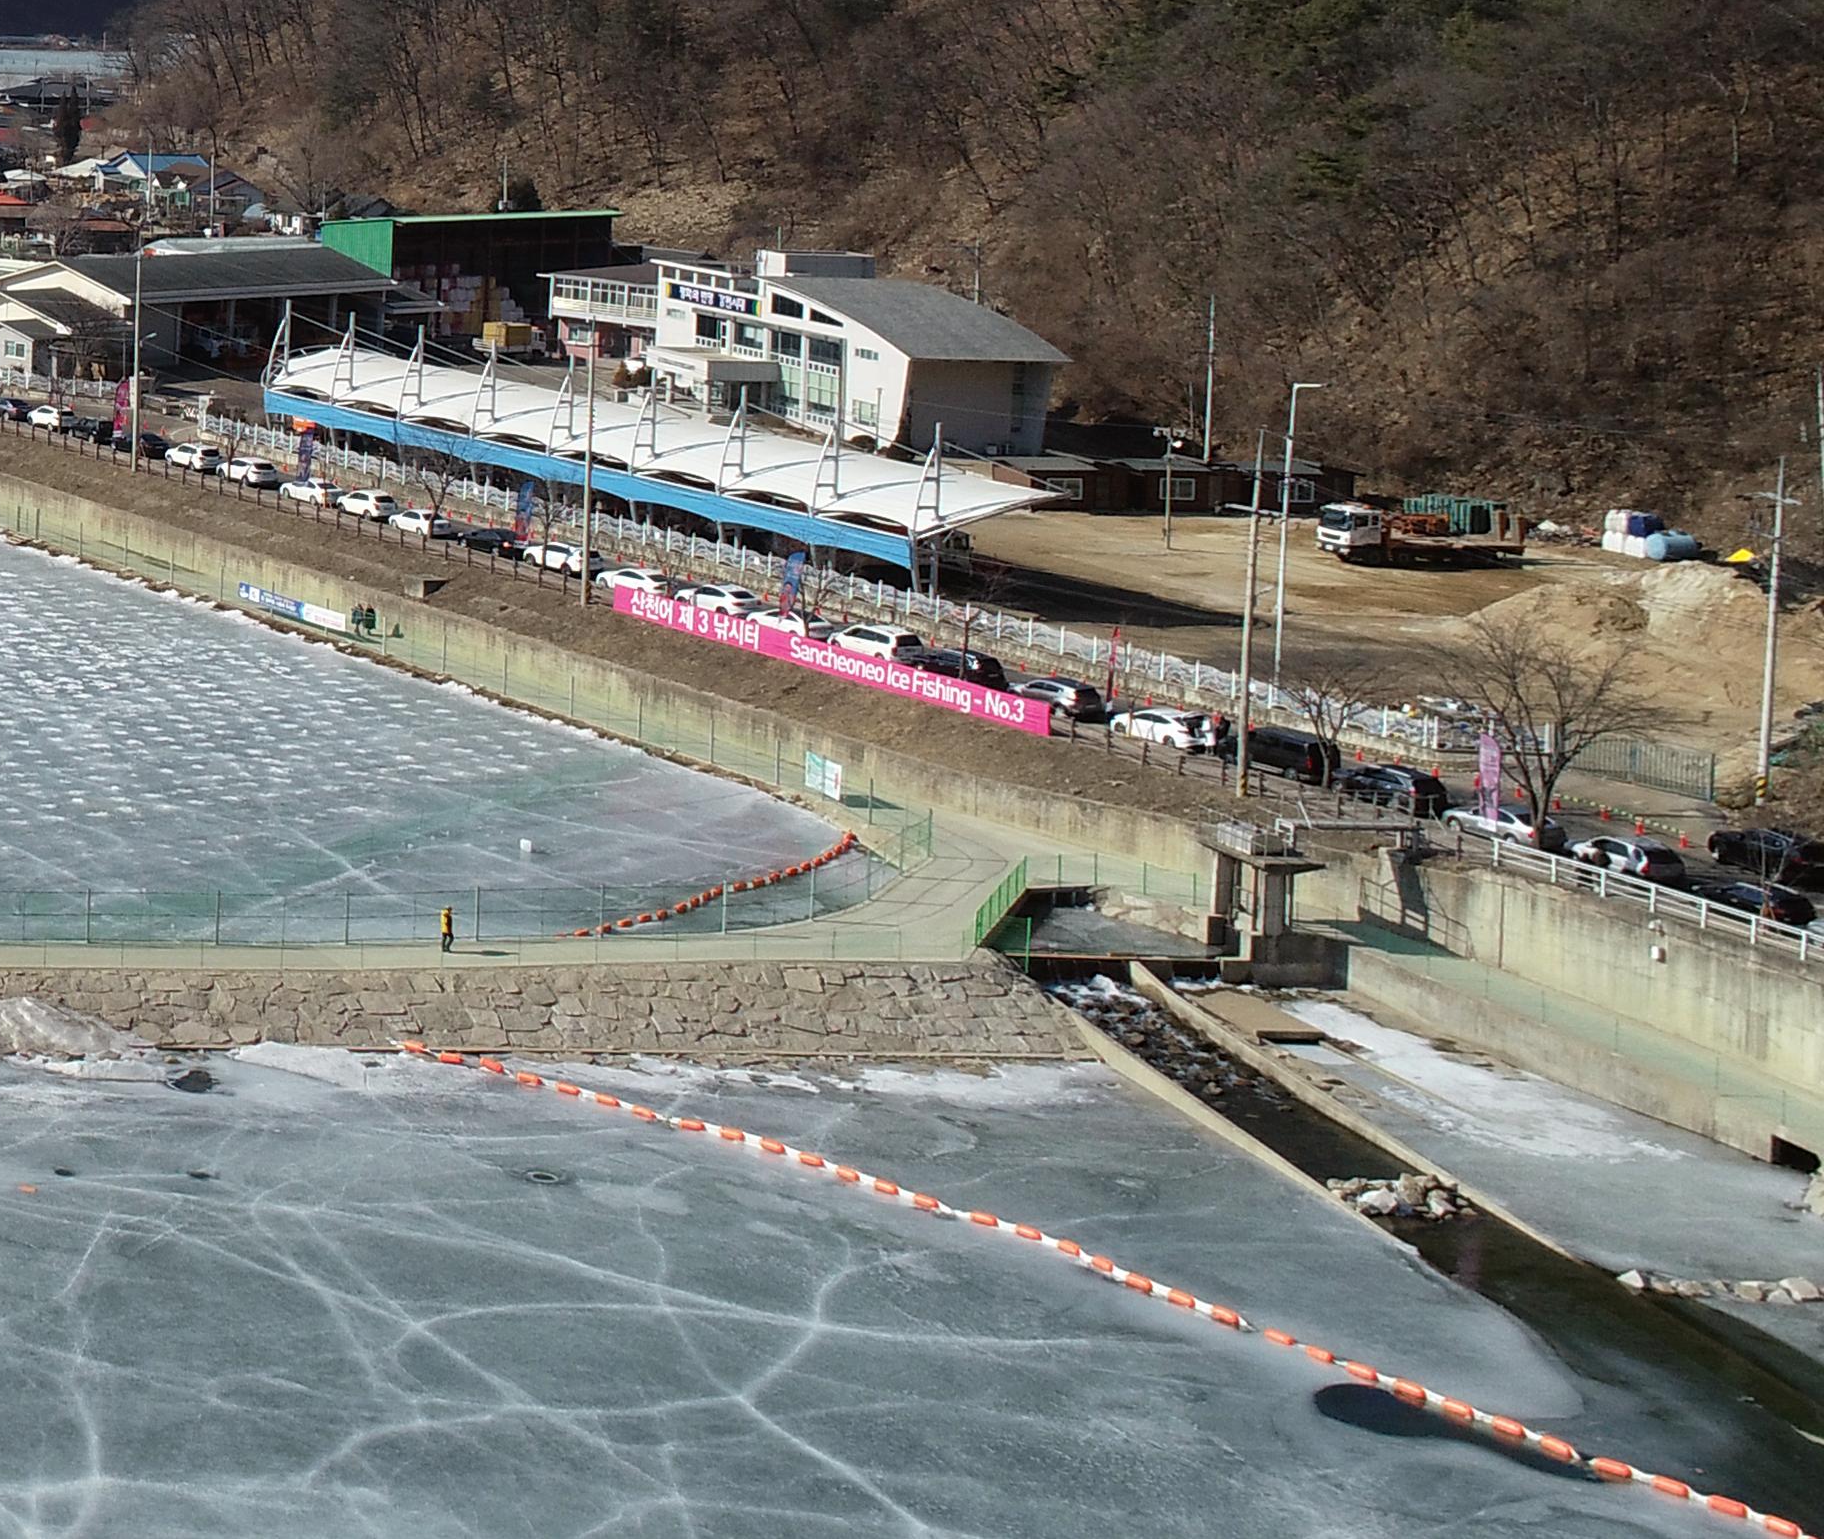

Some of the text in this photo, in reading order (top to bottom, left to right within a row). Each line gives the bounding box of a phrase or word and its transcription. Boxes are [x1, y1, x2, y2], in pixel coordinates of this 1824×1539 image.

[630, 590, 760, 650] 산천어 제 3 낚시터
[789, 636, 885, 683] Sancheoneo
[886, 663, 911, 690] Ice
[912, 671, 971, 713] Fishing
[984, 691, 1025, 723] No.3
